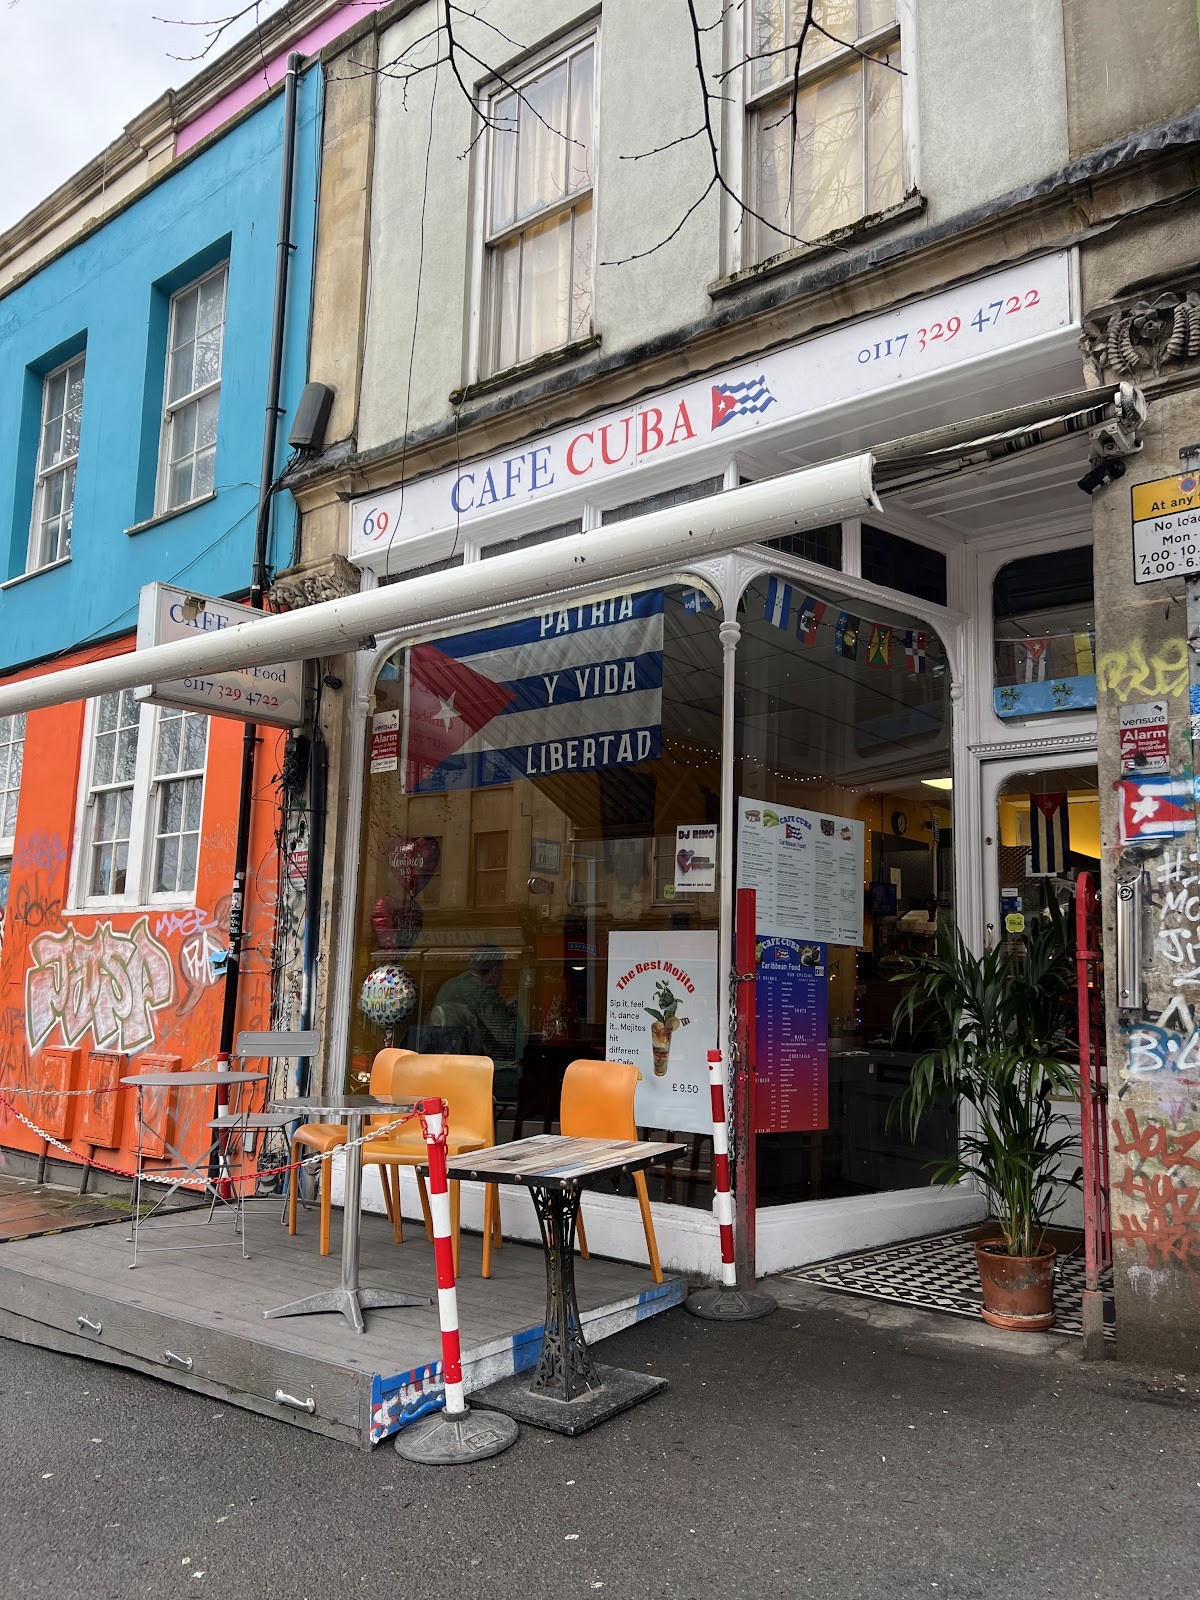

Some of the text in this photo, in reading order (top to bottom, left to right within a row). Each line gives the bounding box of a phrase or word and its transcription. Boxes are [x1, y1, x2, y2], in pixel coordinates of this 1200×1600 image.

[857, 288, 1041, 364] 0117 329 4722
[451, 403, 697, 514] CAFE CUBA
[1151, 495, 1194, 513] At any
[362, 507, 390, 542] 69
[1154, 521, 1173, 533] No
[1162, 533, 1190, 546] Mon
[1139, 549, 1170, 565] 7.00
[1181, 544, 1200, 556] 10.
[1142, 561, 1175, 577] 4.00
[539, 593, 635, 638] PATRIA
[252, 667, 287, 684] Food
[543, 661, 637, 704] Y VIDA
[183, 677, 279, 706] 0117 329 4722
[1122, 715, 1166, 727] verisure
[373, 733, 398, 744] Alarm
[1123, 729, 1167, 742] Alarm
[525, 730, 652, 776] LIBERTAD
[1138, 743, 1166, 751] recorded
[779, 815, 812, 831] CAFE CUBA
[678, 830, 690, 840] DJ
[779, 838, 806, 850] Caribbean Food
[762, 937, 800, 953] CAFE CUBA
[761, 961, 801, 971] Caribbean Food
[615, 959, 696, 994] The Best Mojito
[373, 987, 394, 999] LOVE
[371, 1001, 387, 1013] YOU
[609, 1000, 621, 1008] Sip
[630, 1000, 644, 1008] feel
[617, 1012, 640, 1020] dance
[620, 1023, 646, 1032] Mojitos
[609, 1034, 618, 1042] hit
[608, 1046, 639, 1055] different
[672, 1083, 699, 1094] £ 9.50
